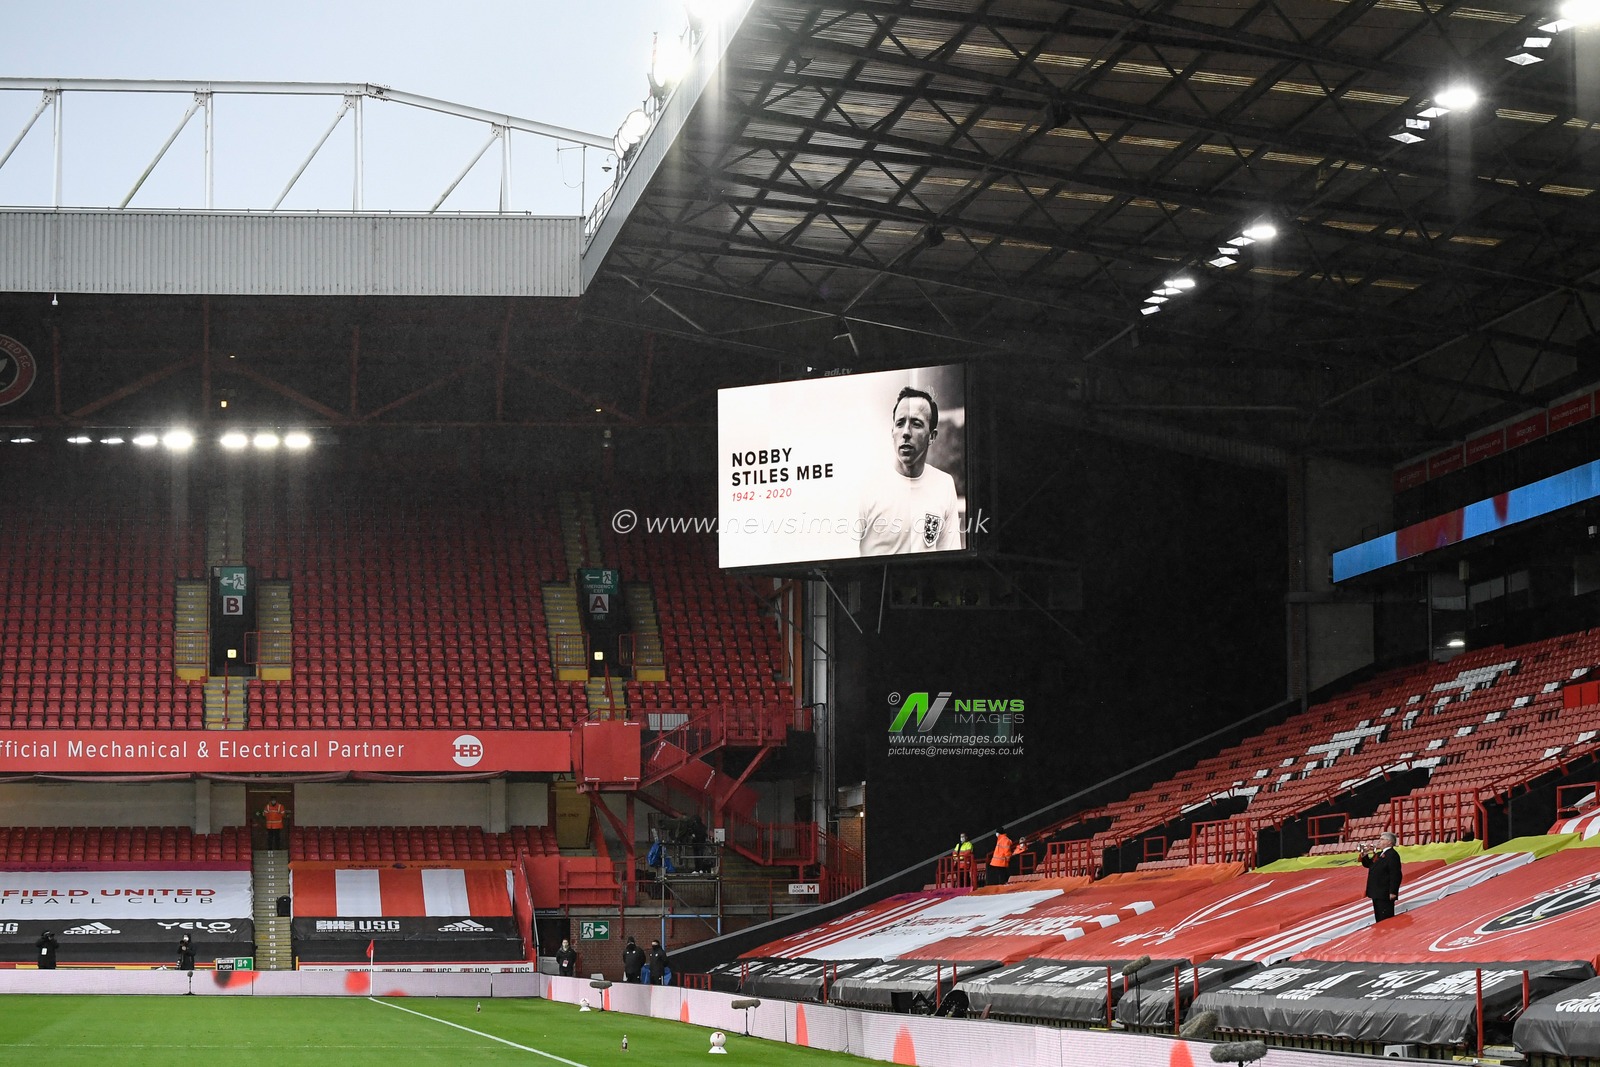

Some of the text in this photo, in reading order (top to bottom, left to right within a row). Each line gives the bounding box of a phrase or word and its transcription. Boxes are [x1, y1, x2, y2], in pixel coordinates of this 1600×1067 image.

[824, 367, 853, 376] adi.tv
[732, 447, 792, 467] NOBBY
[731, 463, 834, 486] STILES MBE
[732, 490, 755, 502] 1942
[766, 487, 792, 499] 2020
[226, 598, 239, 613] B
[591, 596, 607, 611] A
[67, 740, 188, 758] Mechanical
[197, 741, 209, 758] &
[220, 740, 318, 758] Electrical
[328, 741, 405, 758] Partner
[101, 889, 216, 897] UNITED
[807, 885, 815, 893] M
[157, 921, 231, 930] YELO
[358, 920, 400, 930] USG
